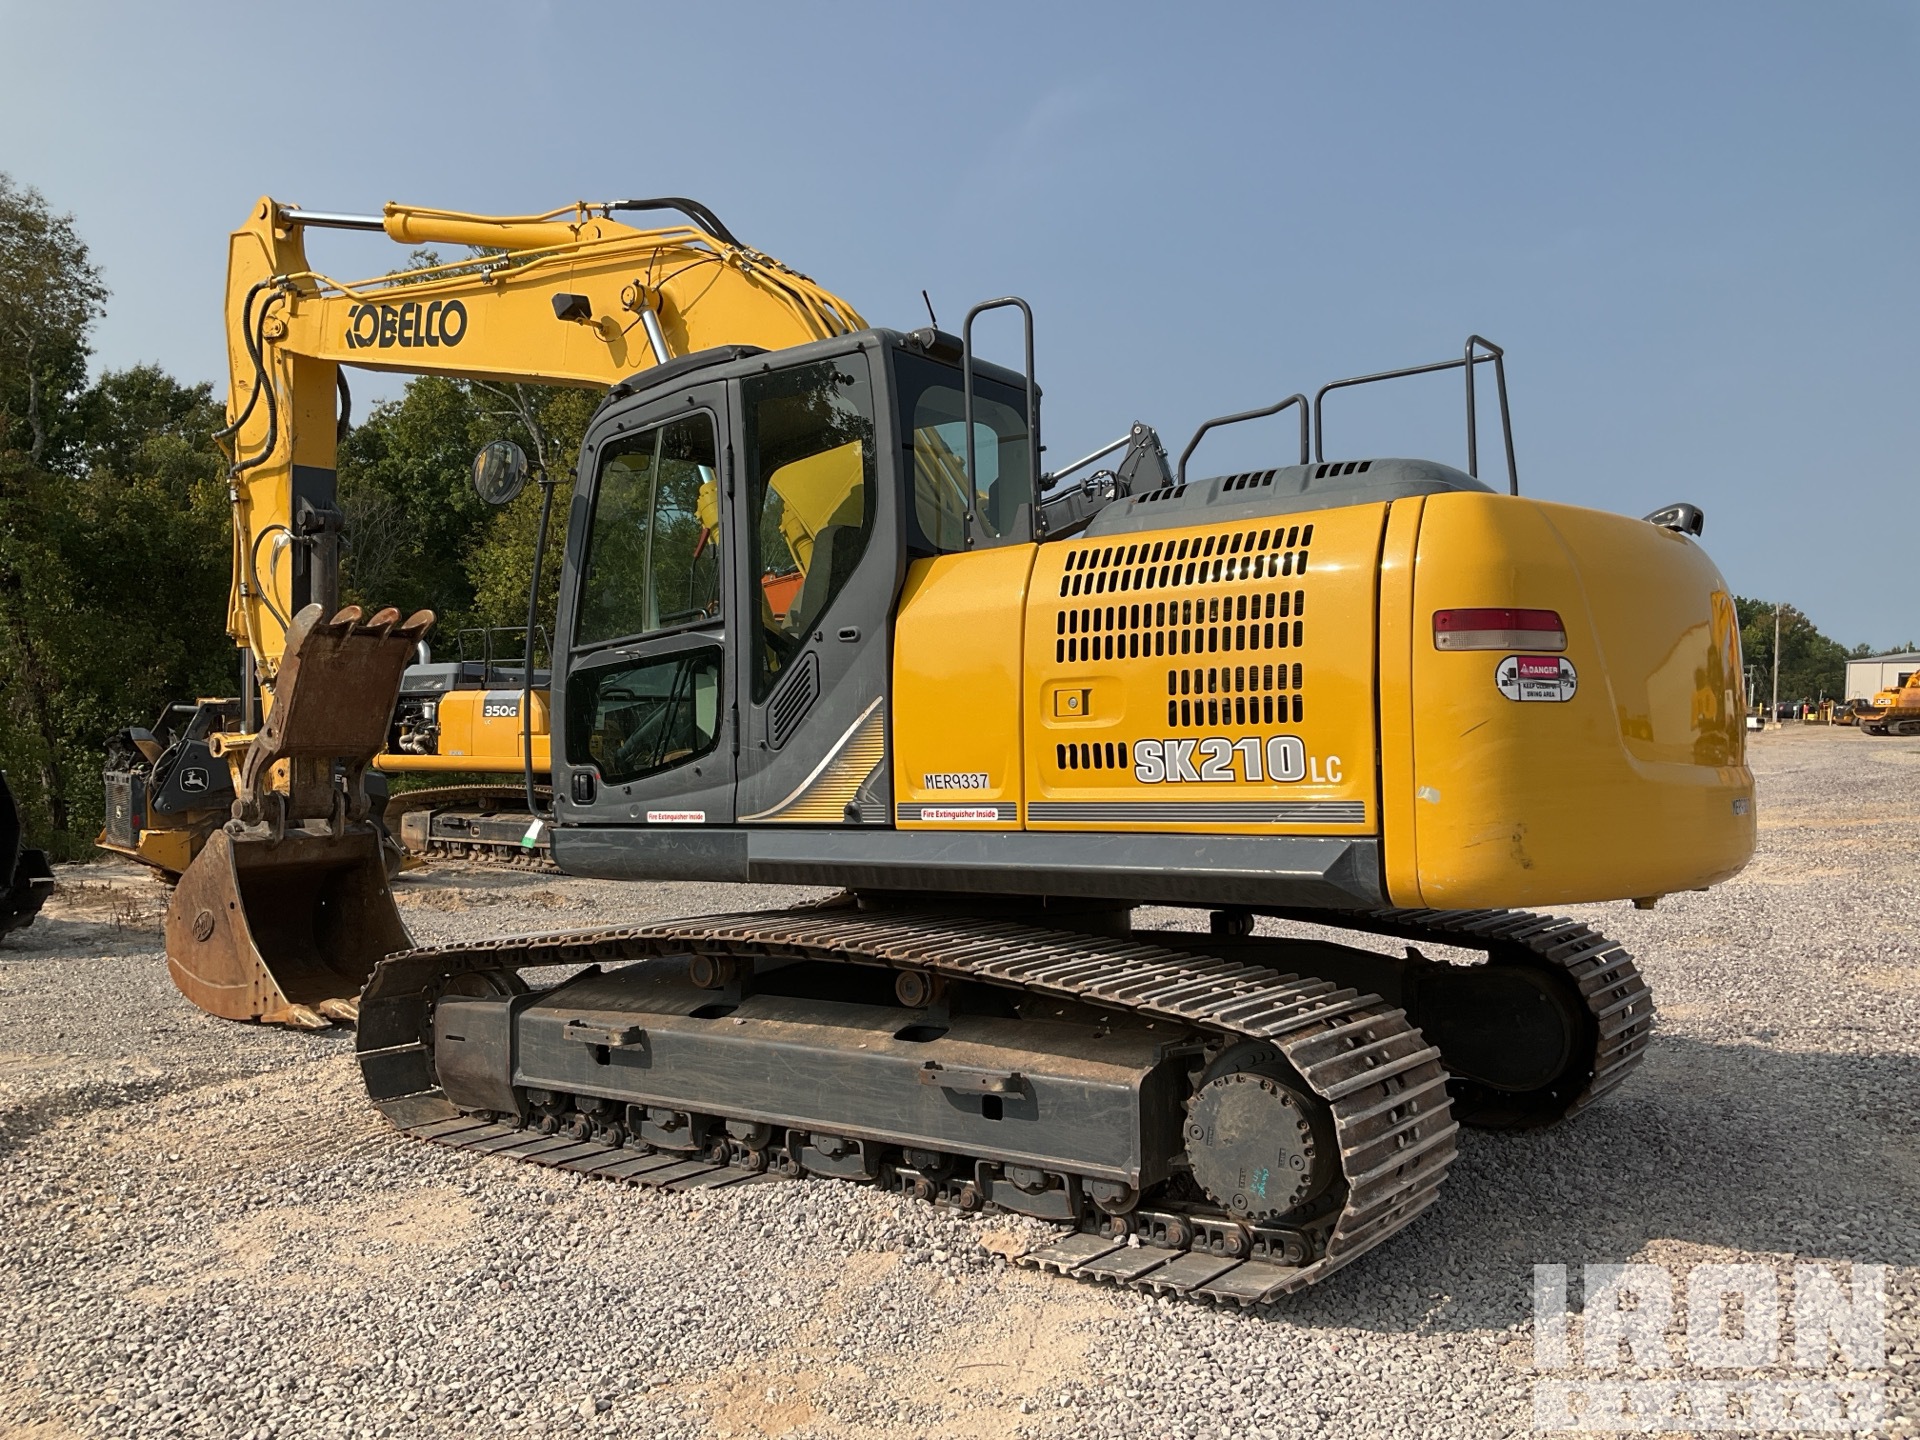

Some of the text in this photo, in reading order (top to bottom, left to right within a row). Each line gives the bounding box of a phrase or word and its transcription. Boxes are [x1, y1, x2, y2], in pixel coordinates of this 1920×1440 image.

[1528, 666, 1558, 674] DANGER
[1527, 690, 1556, 698] SWING AREA
[485, 705, 517, 717] 350G
[1133, 735, 1342, 784] SK210 LC
[925, 774, 988, 790] MER9337
[658, 813, 688, 821] Extinguisher
[923, 810, 995, 820] Fire Extinguisher Inside
